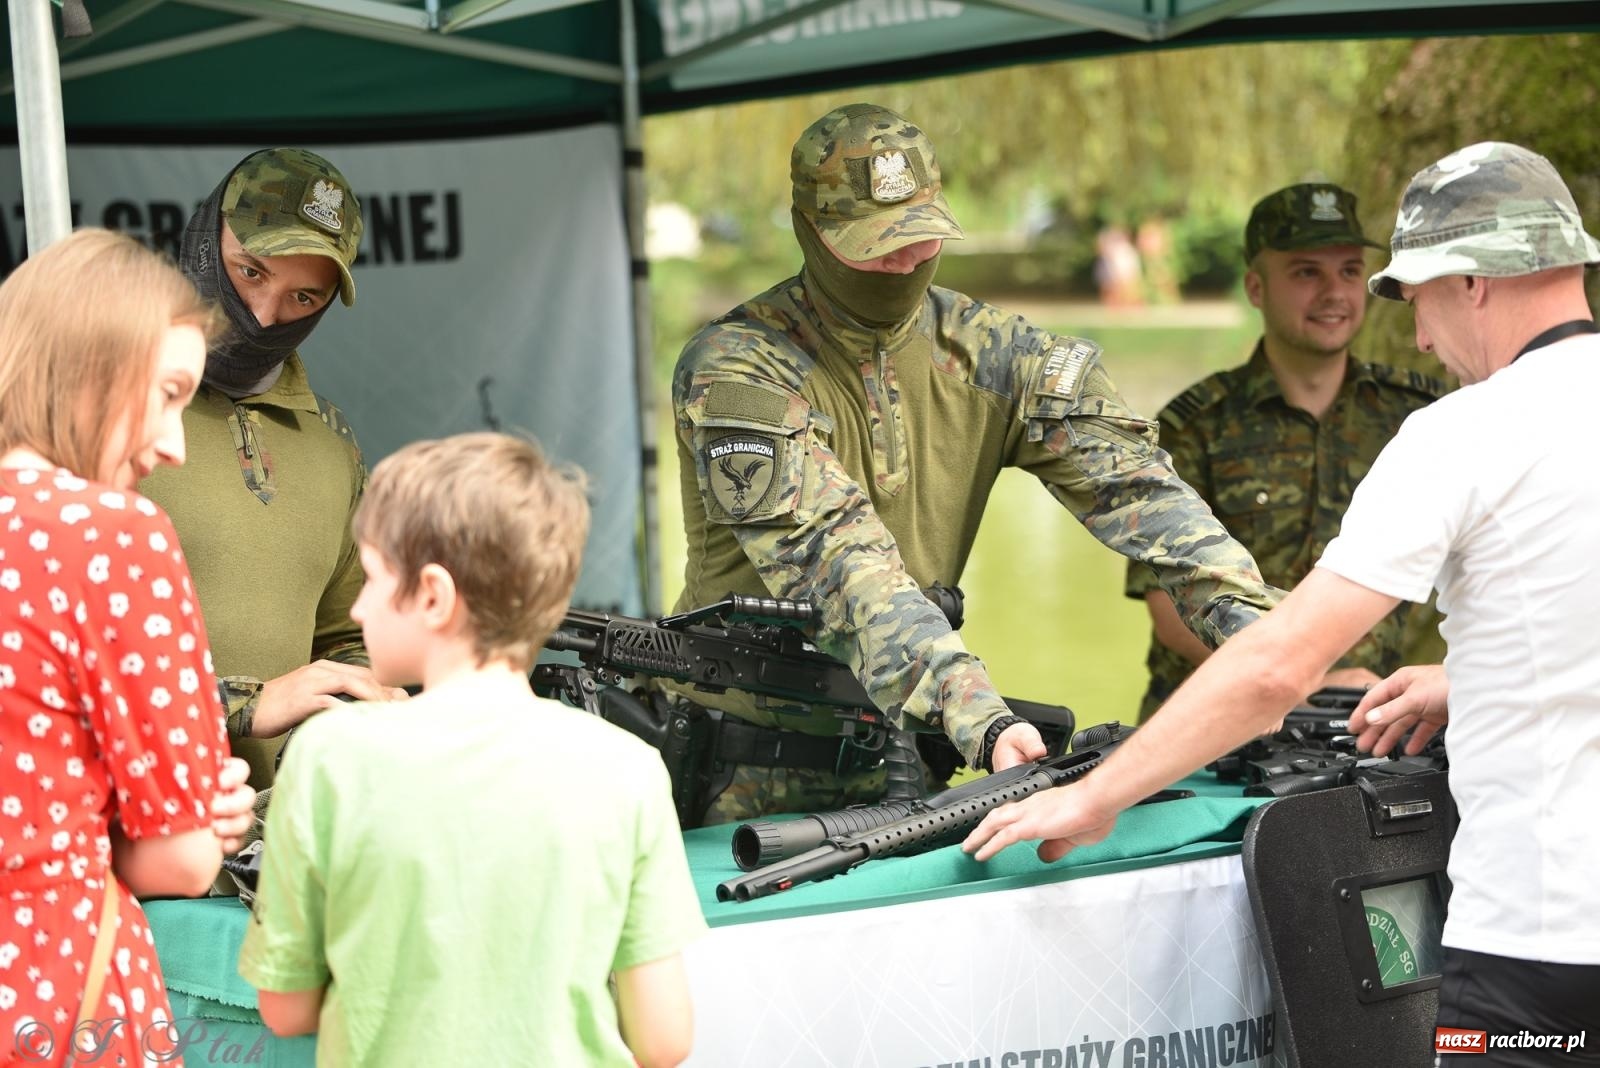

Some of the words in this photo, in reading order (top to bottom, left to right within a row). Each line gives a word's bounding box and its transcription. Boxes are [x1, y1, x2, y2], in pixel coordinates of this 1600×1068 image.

[710, 443, 734, 458] STRAŻ
[734, 443, 774, 457] GRANICZNA
[1366, 913, 1400, 949] DZIAŁ
[1399, 951, 1414, 975] SG
